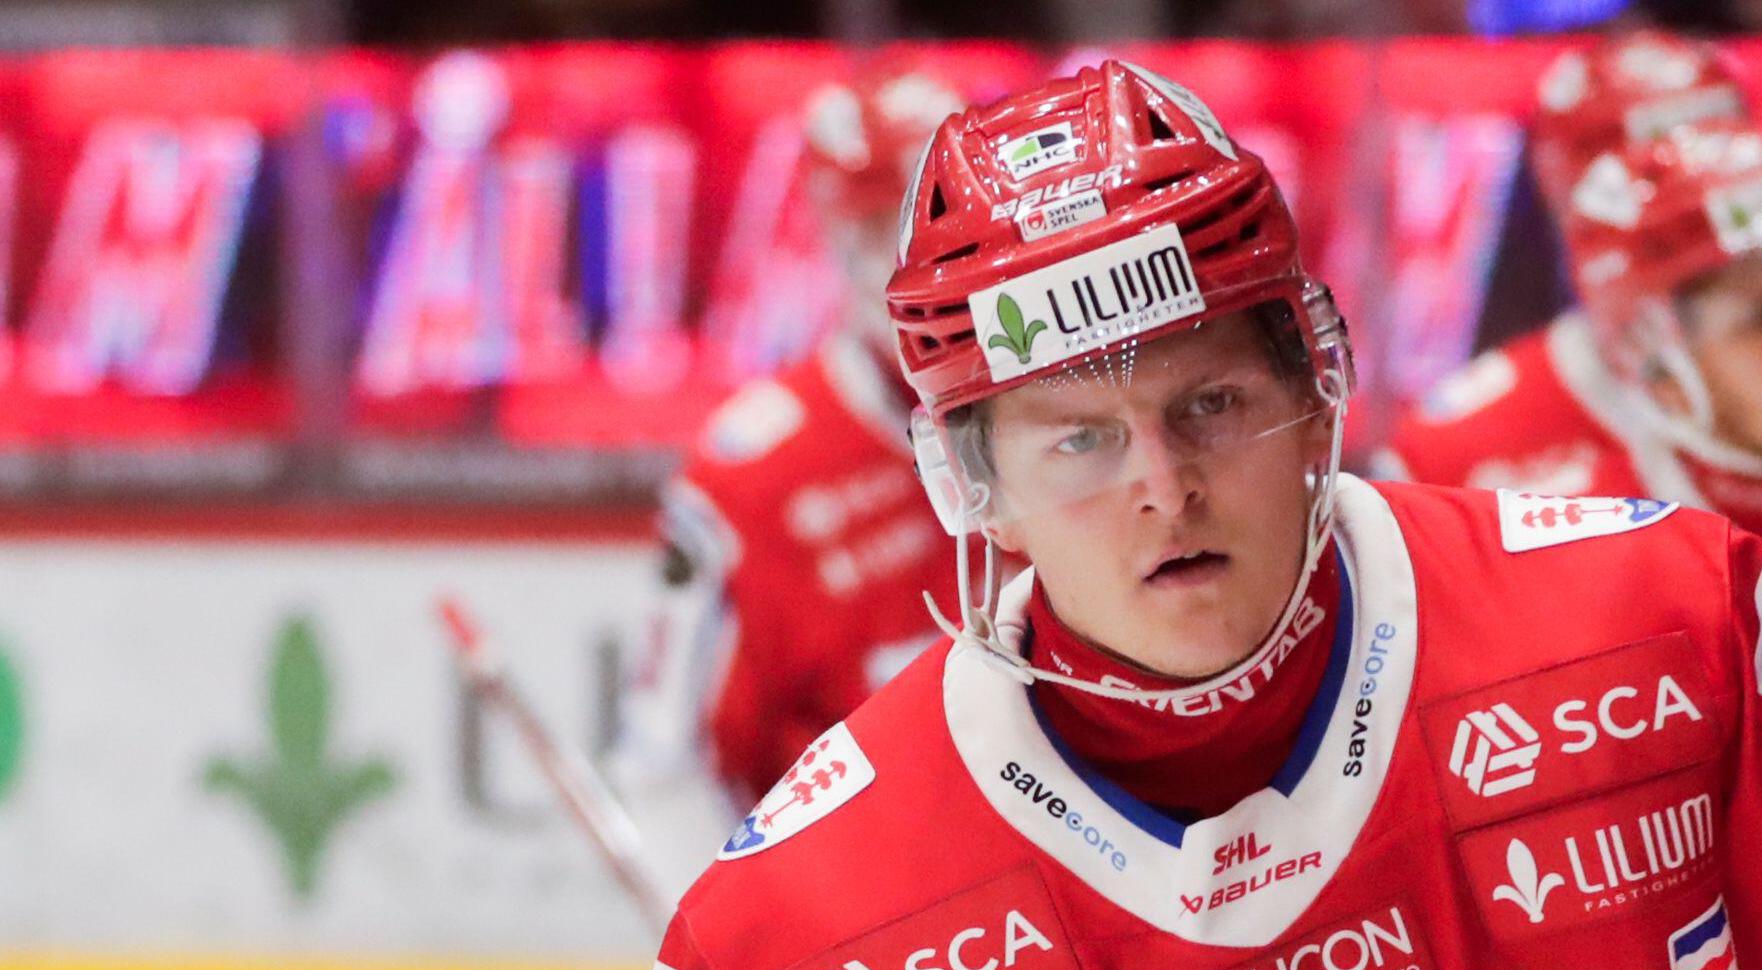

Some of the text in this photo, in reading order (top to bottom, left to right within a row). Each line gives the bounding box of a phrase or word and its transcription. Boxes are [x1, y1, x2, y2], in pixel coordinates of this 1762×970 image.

[1047, 196, 1099, 218] SVENSKA
[1050, 213, 1079, 228] SPEL
[1046, 245, 1193, 334] LILIUM
[1342, 620, 1398, 778] savecore
[1552, 674, 1703, 755] SCA
[999, 760, 1128, 873] savecore
[1212, 831, 1272, 876] SHL
[1565, 793, 1714, 894] LILIUM
[1206, 848, 1323, 912] BAUER
